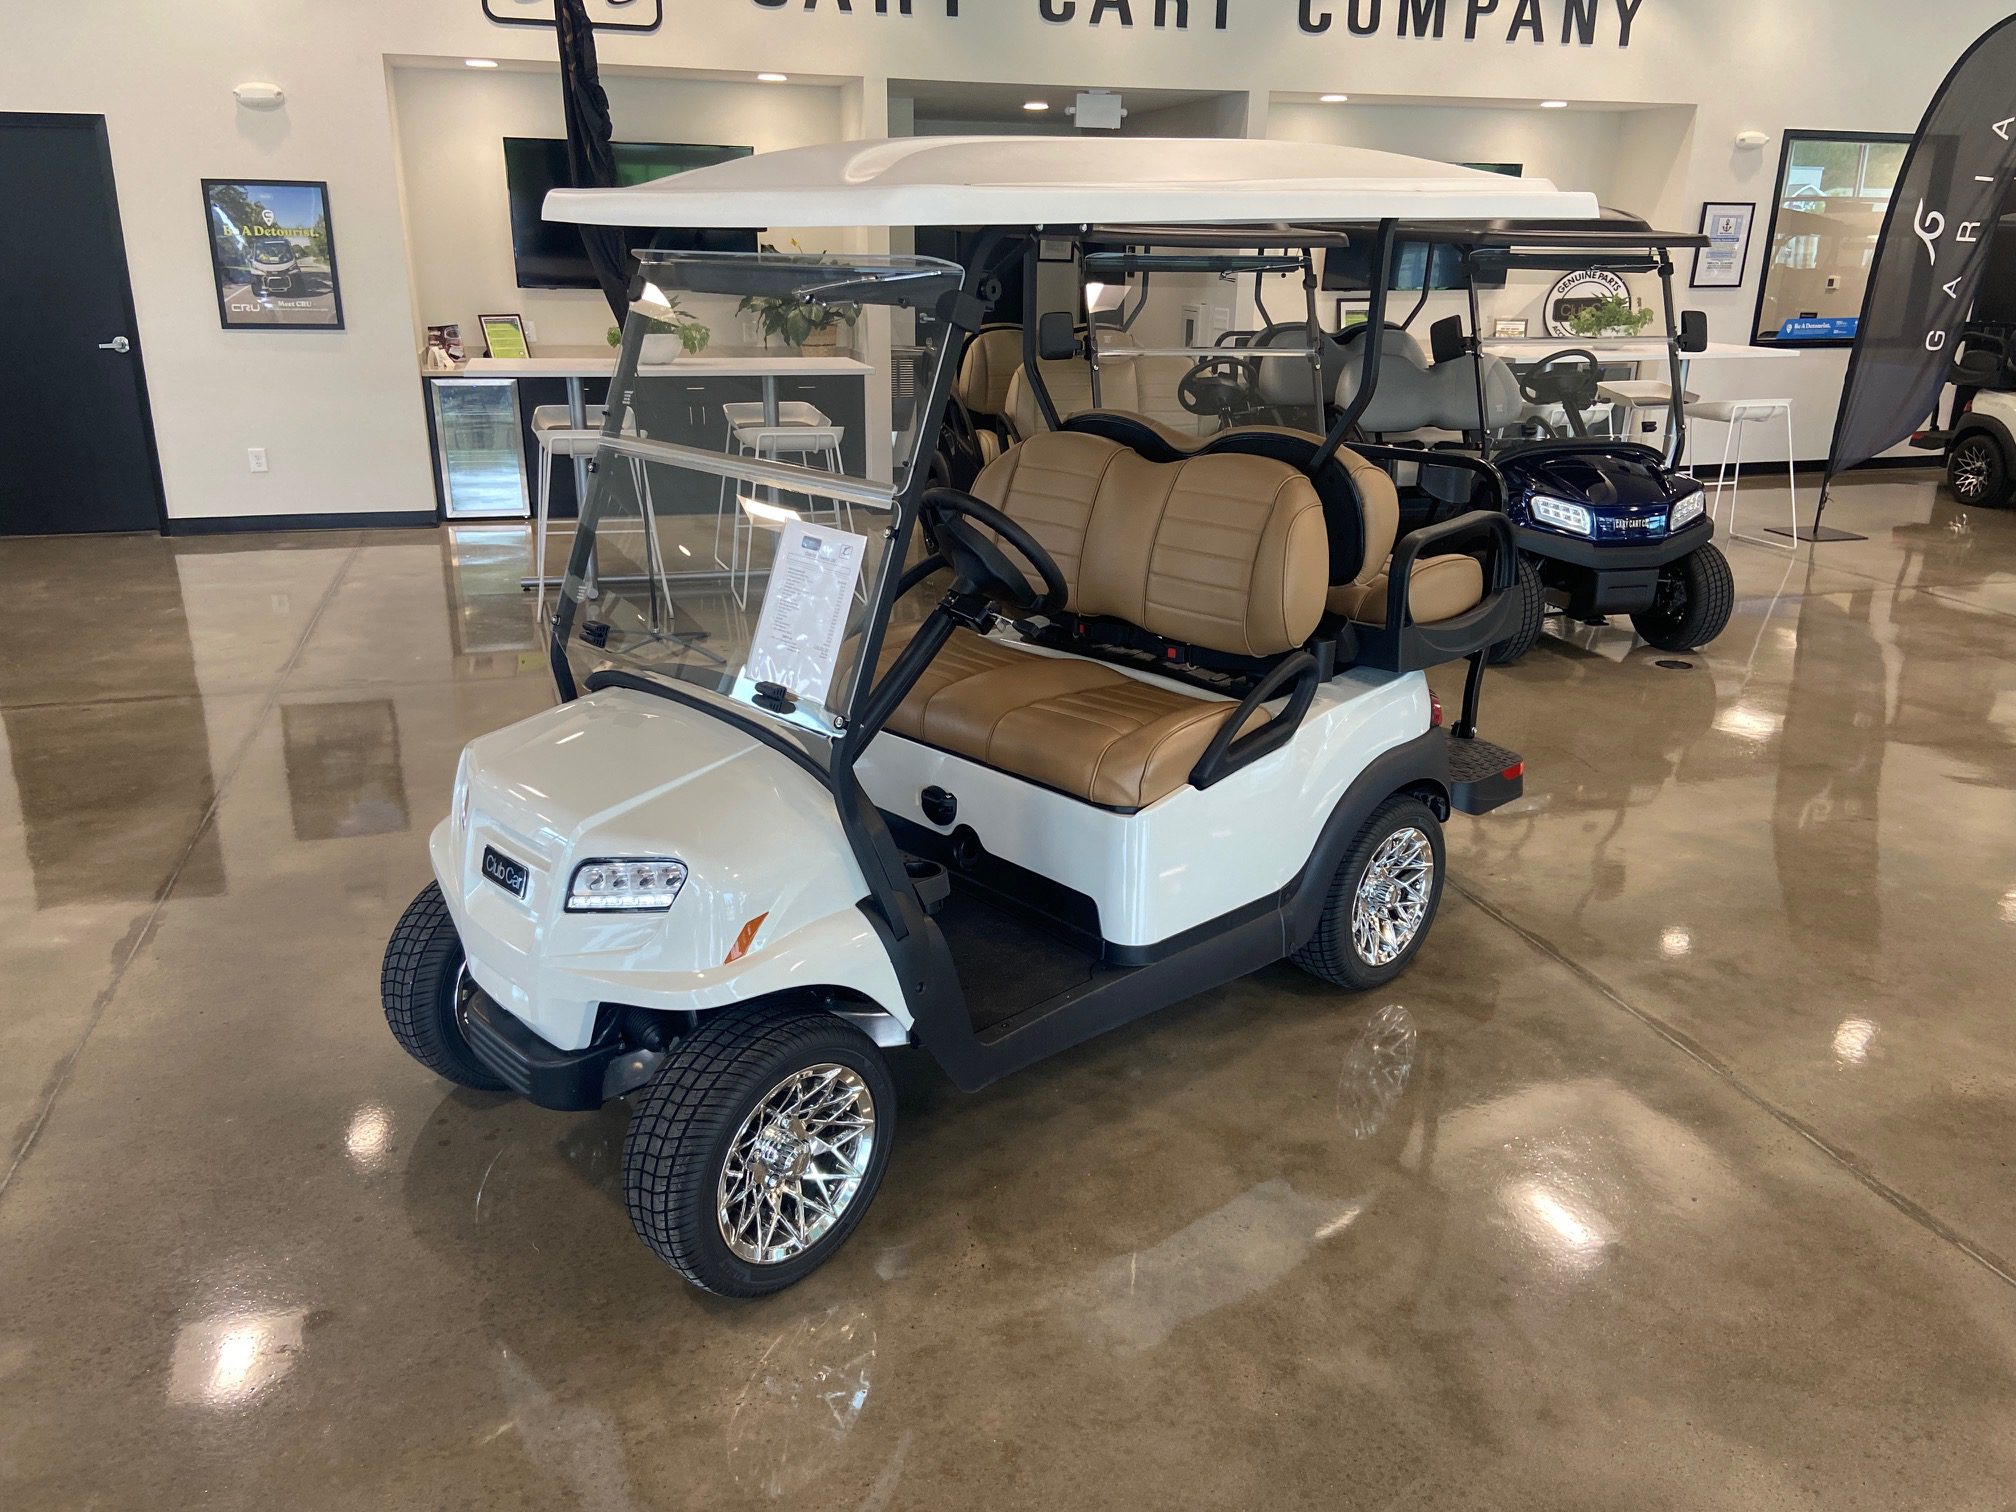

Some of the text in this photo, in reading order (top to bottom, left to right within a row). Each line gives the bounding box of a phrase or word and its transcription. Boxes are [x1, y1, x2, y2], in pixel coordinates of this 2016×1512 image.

[1299, 0, 1642, 47] COMPANY
[242, 225, 252, 236] A
[254, 226, 320, 238] Detourist.
[1925, 116, 2016, 351] GARIA
[1557, 271, 1622, 294] GENUINE PARTS
[231, 304, 261, 312] CRU
[486, 854, 523, 890] Club Car
